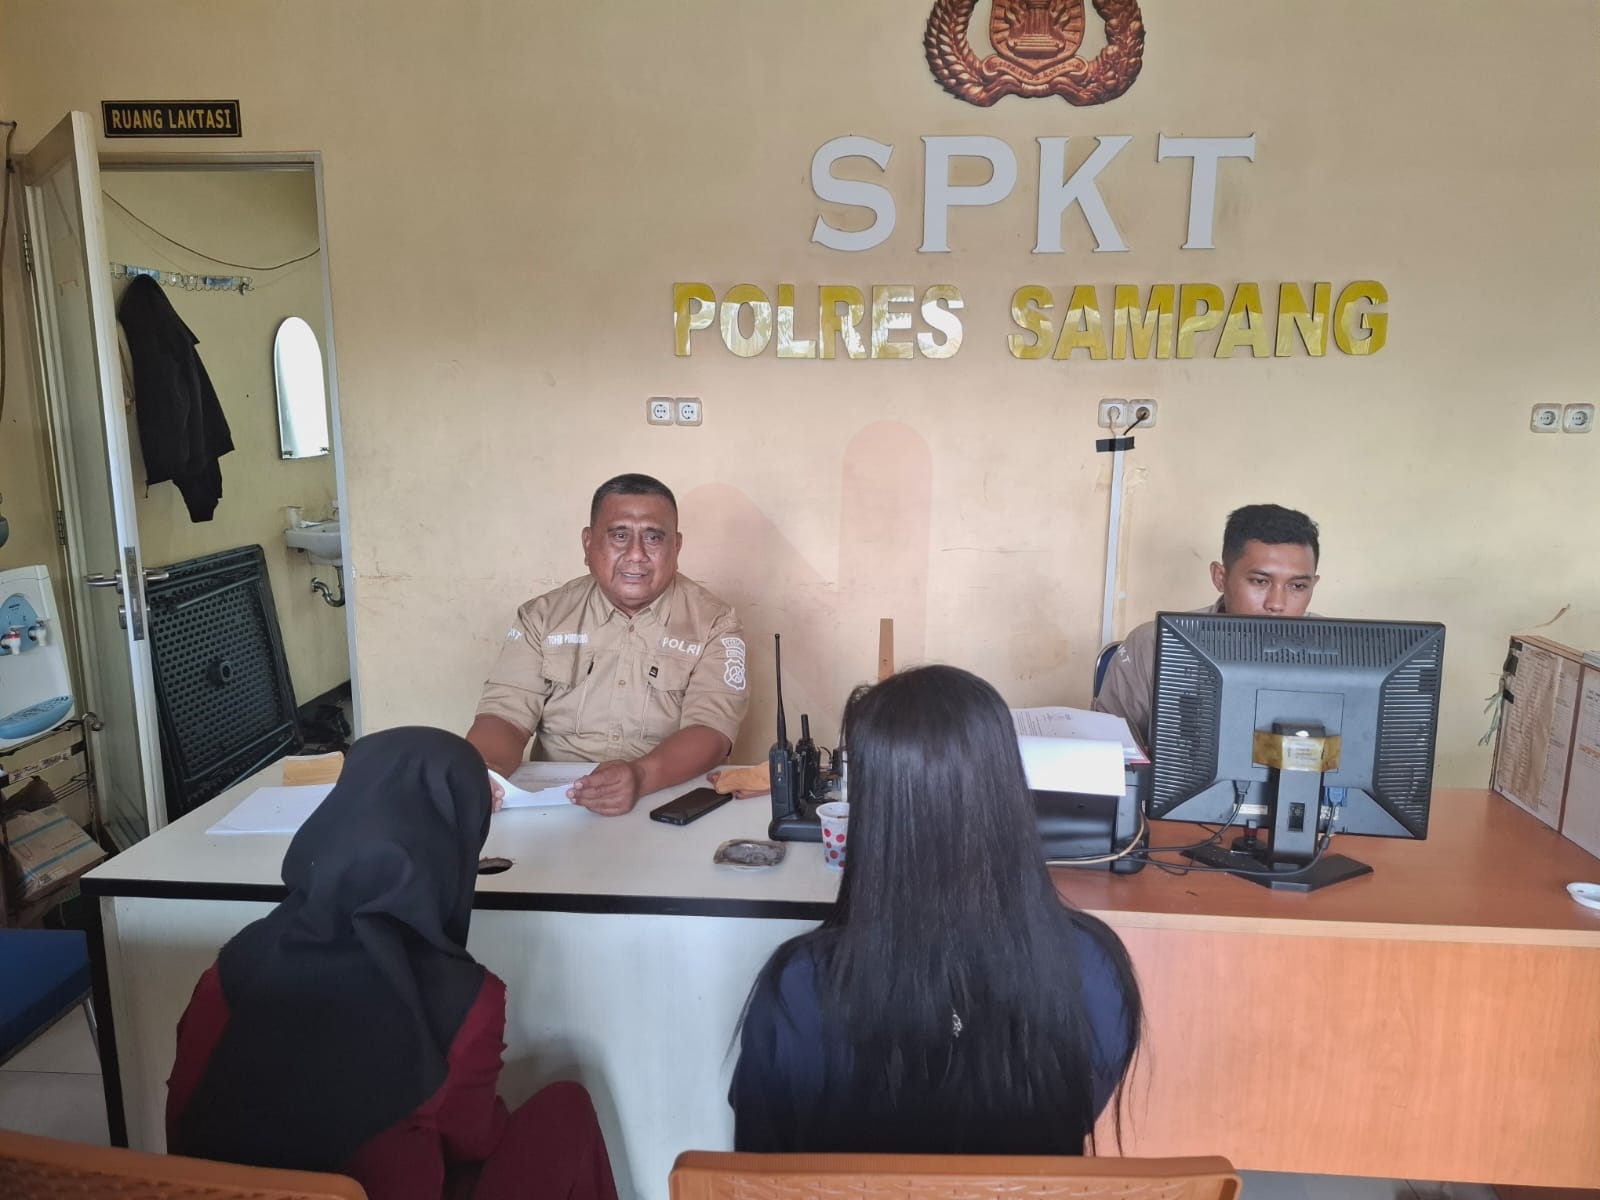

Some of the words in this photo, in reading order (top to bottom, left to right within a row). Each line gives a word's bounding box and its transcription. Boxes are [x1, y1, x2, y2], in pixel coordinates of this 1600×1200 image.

[111, 109, 163, 129] RUANG
[168, 109, 232, 129] LAKTASI
[810, 132, 1256, 253] SPKT
[672, 282, 965, 360] POLRES
[1006, 280, 1389, 360] SAMPANG
[662, 637, 701, 656] POLRI
